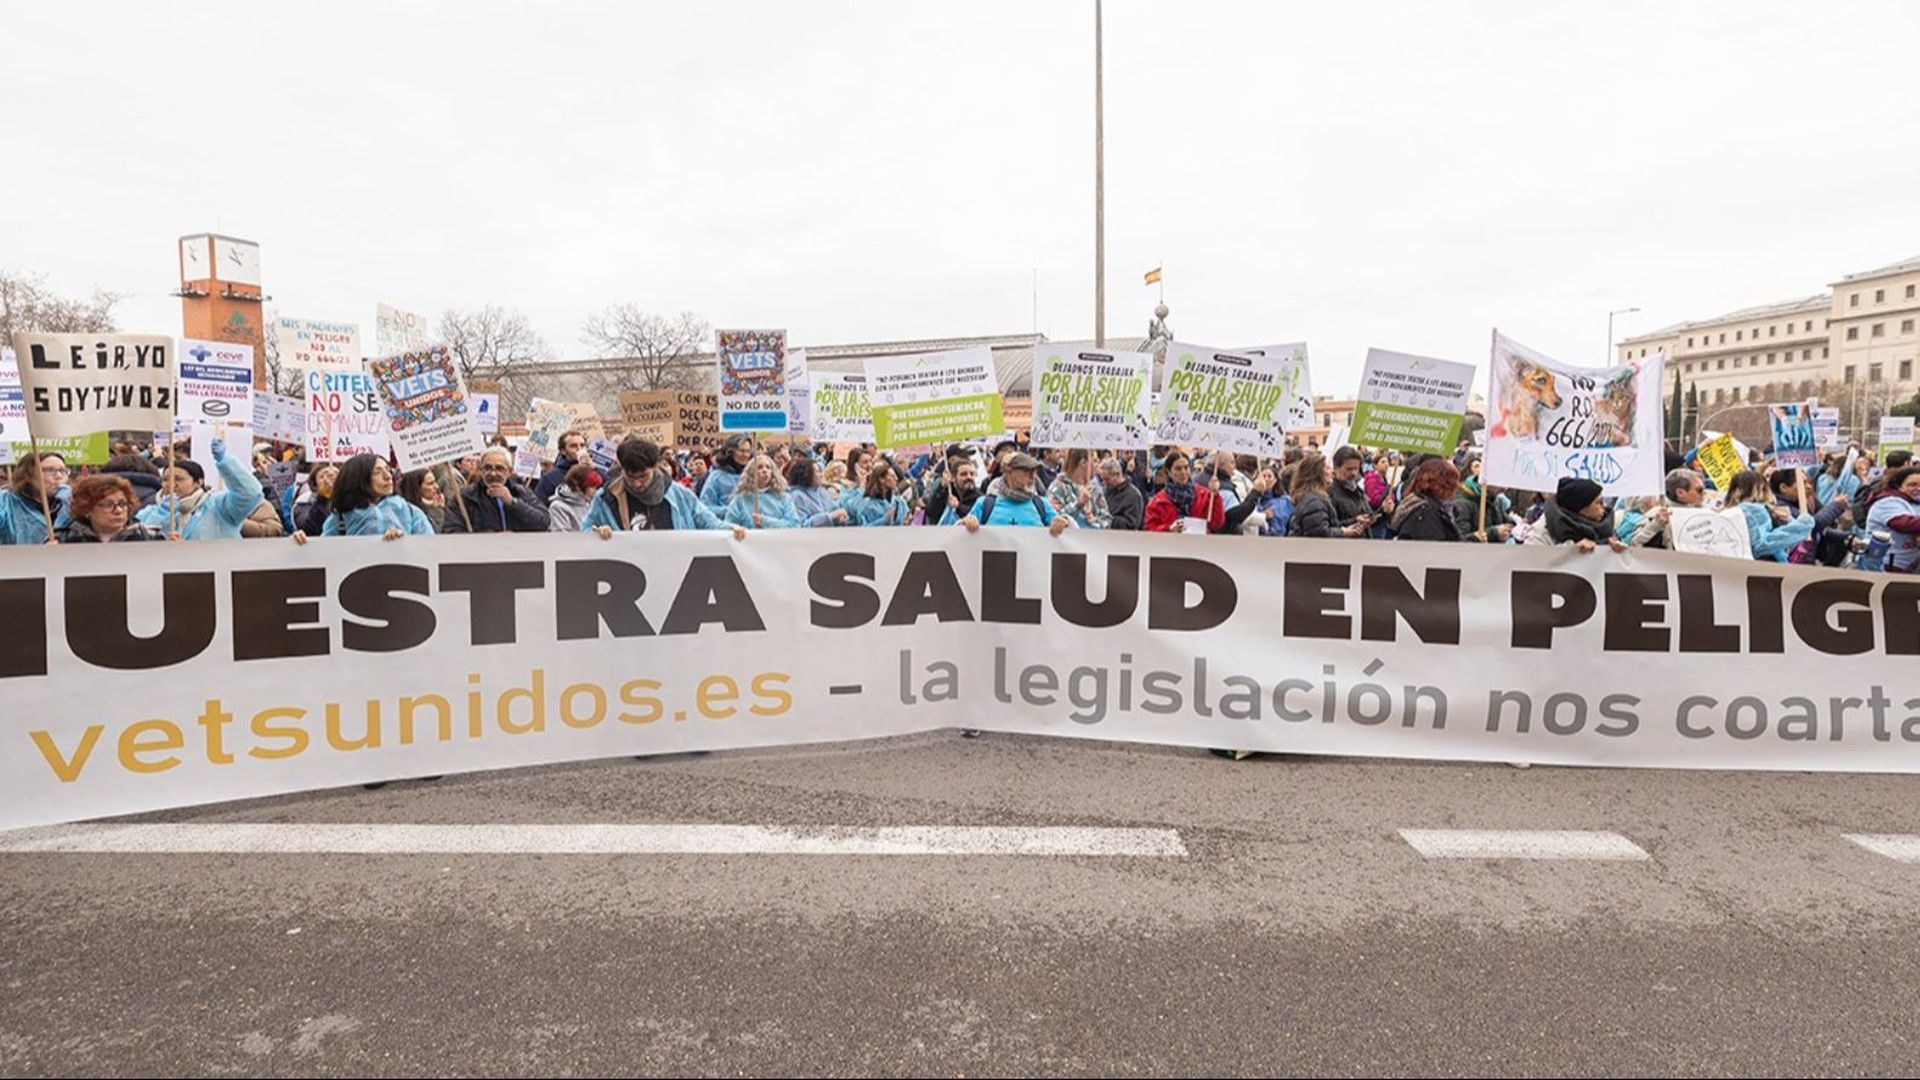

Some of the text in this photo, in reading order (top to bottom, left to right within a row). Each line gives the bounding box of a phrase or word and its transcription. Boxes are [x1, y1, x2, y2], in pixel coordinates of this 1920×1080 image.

[298, 332, 351, 343] EN PELIGRO
[311, 343, 342, 353] NO AL
[296, 352, 350, 363] RD 666/23
[728, 351, 776, 369] VETS
[737, 370, 771, 379] UNIDOS
[1053, 363, 1135, 377] DEJADNOS TRABAJAR
[1184, 361, 1275, 384] DEJADNOS TRABAJAR
[387, 369, 449, 400] VETS
[1040, 372, 1143, 400] POR LA SALUD
[1169, 370, 1282, 406] POR LA SALUD
[313, 392, 379, 413] NO SE
[404, 390, 446, 408] UNIDOS
[678, 393, 700, 404] CON
[726, 400, 782, 410] NO RD 666
[815, 390, 840, 404] POR
[843, 391, 858, 406] LA
[1059, 393, 1137, 415] BIENESTAR
[832, 403, 872, 418] BIENES
[1188, 392, 1275, 422] BIENESTAR
[1064, 412, 1125, 424] DE LOS ANIMALES
[1192, 412, 1259, 430] DE LOS ANIMALES
[682, 422, 704, 433] NOS
[313, 436, 352, 446] NO AL
[677, 436, 724, 448] DERECH
[1565, 452, 1624, 484] SALUD
[806, 550, 1238, 632] SALUD
[1283, 561, 1462, 645] EN
[28, 668, 793, 783] vetsunidos.es
[899, 649, 960, 705] la
[993, 646, 1449, 729] legislación
[1485, 689, 1642, 737] nos
